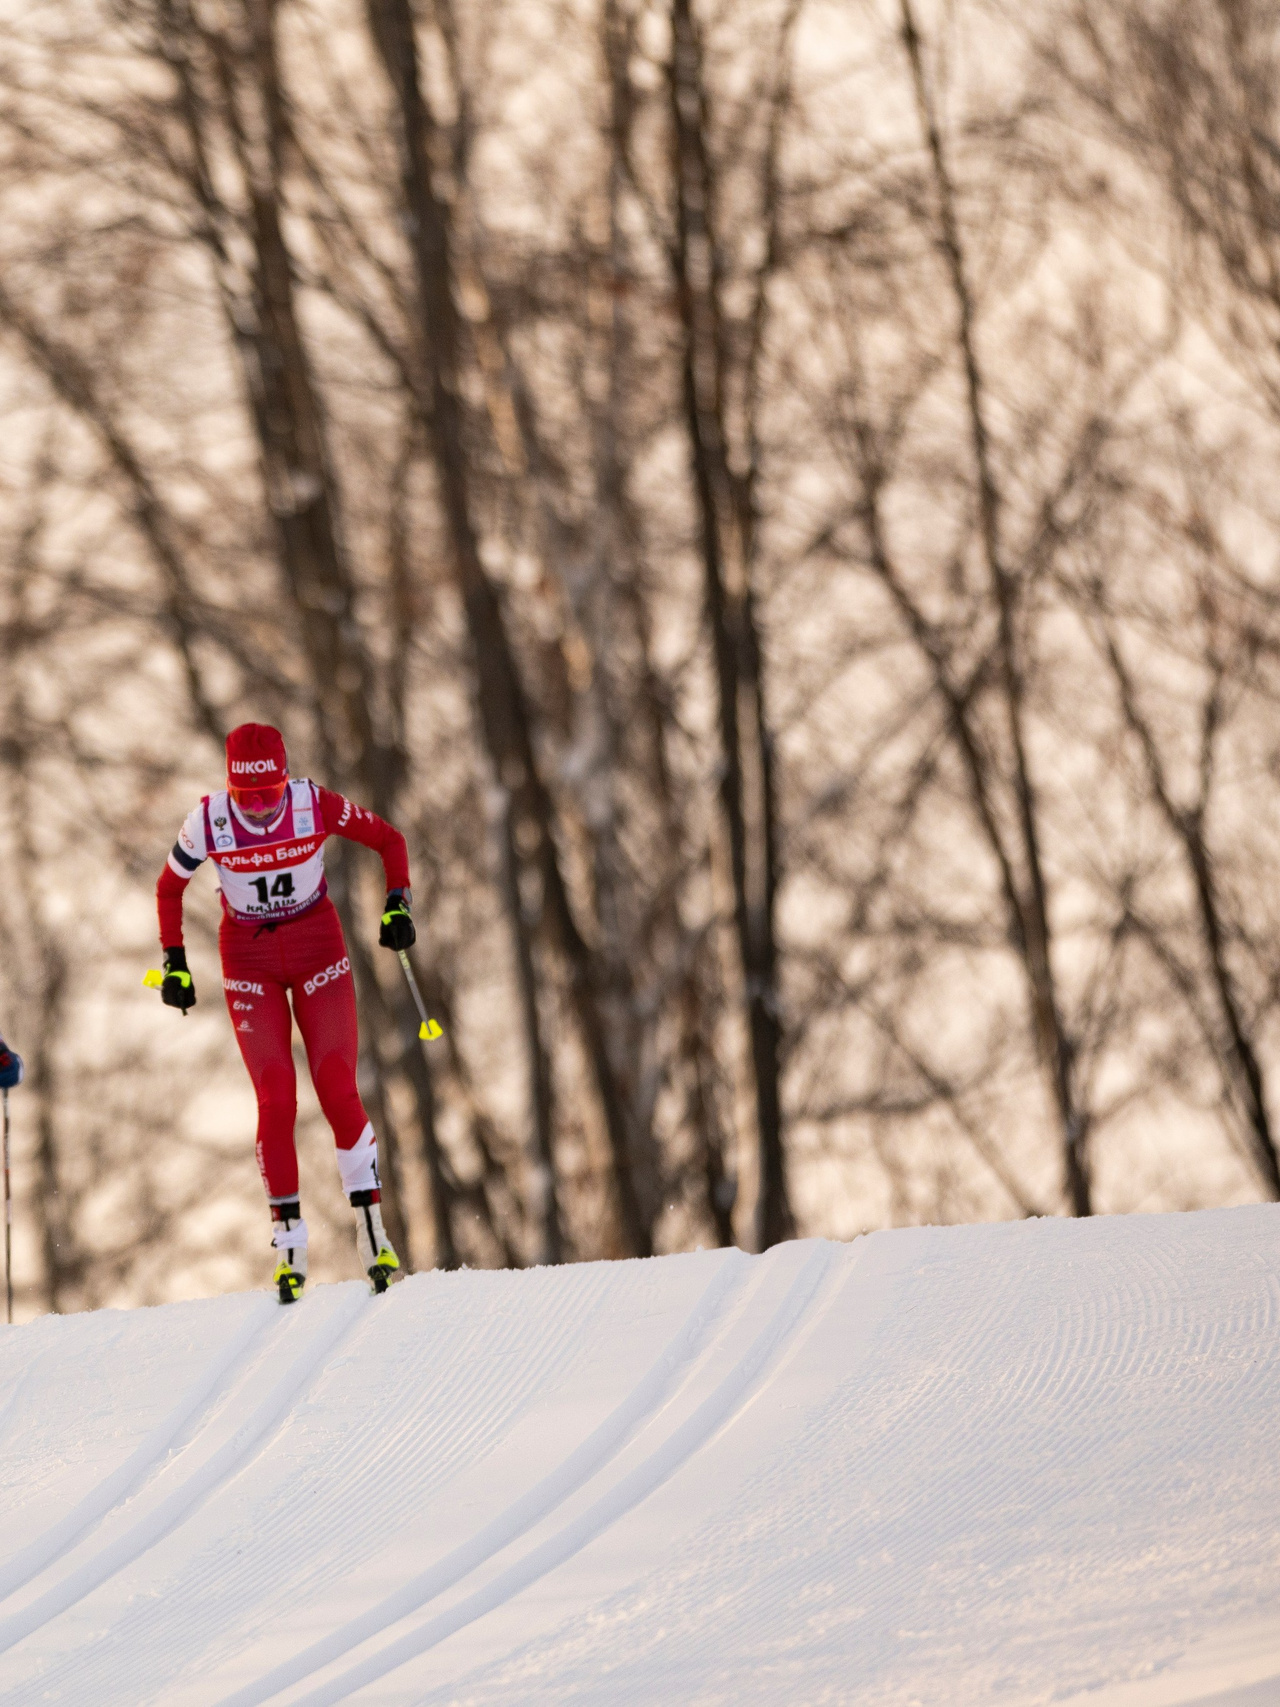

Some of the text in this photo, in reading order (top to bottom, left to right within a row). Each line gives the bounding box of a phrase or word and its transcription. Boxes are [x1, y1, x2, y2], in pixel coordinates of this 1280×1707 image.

[231, 758, 278, 774] LUKOIL
[221, 842, 316, 867] Альфа Банк
[248, 872, 296, 904] 14
[222, 977, 264, 996] UKOIL
[303, 956, 350, 997] BOSCO
